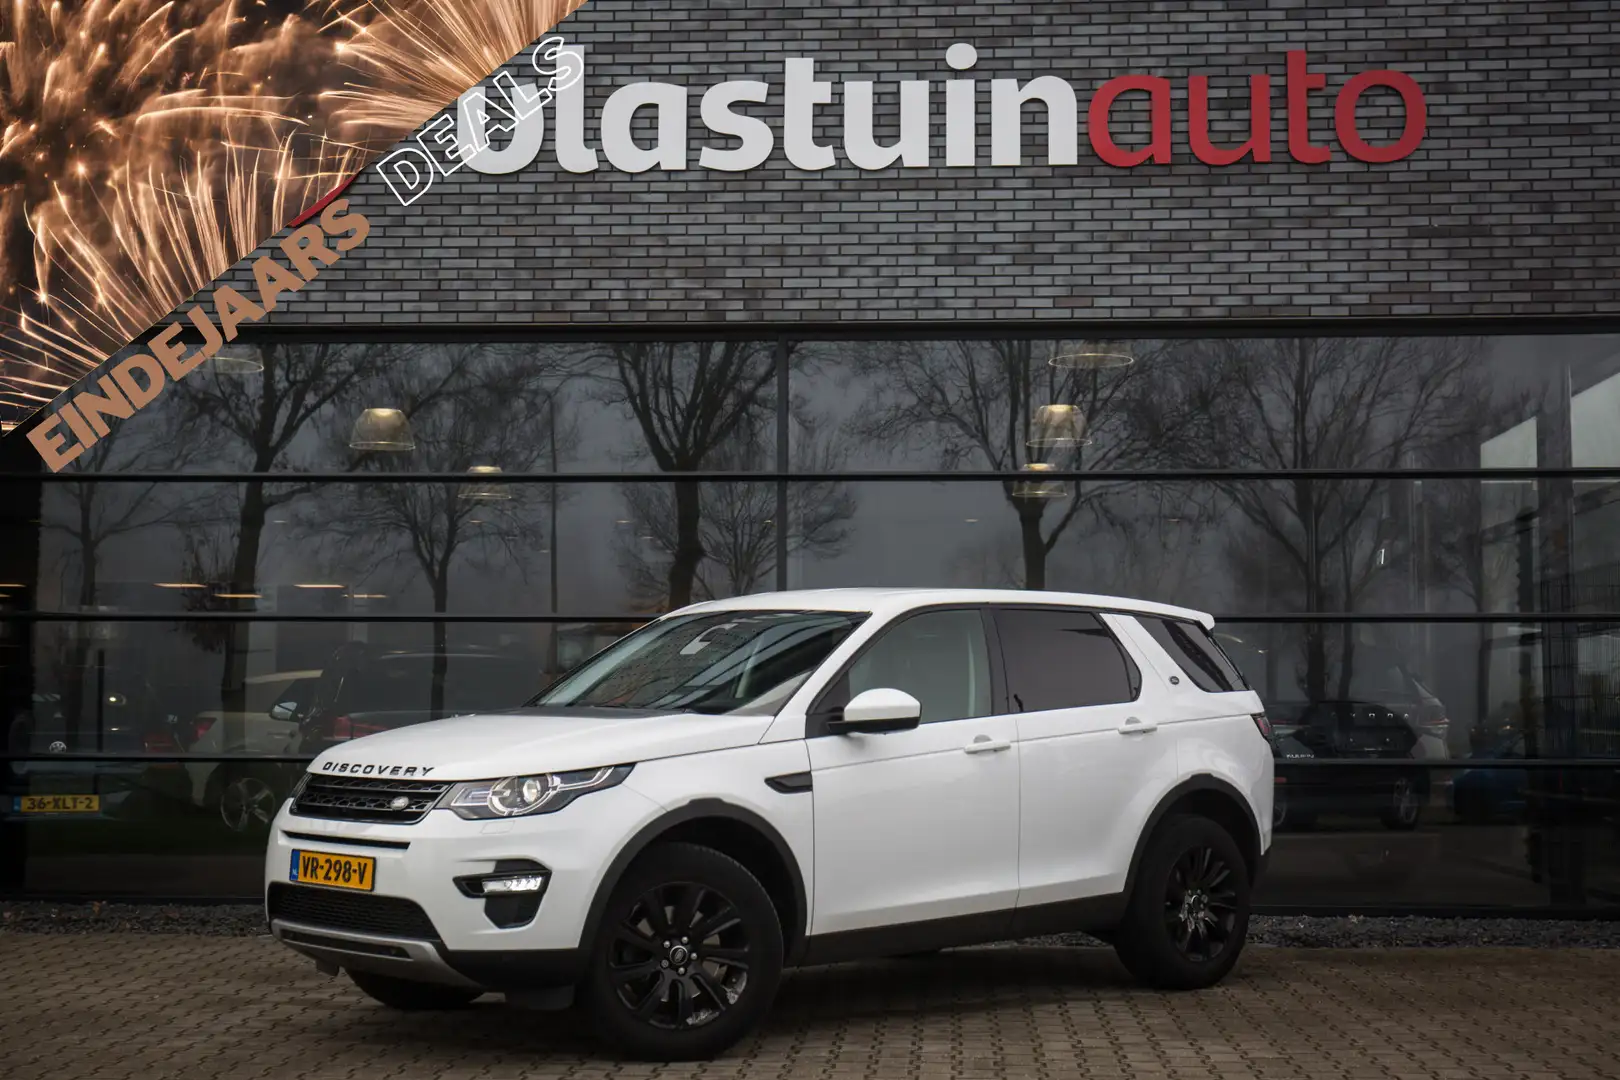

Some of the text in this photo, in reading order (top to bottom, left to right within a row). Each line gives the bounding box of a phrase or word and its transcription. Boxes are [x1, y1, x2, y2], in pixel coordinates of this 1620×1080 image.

[322, 761, 435, 776] DISCOVERY
[26, 797, 94, 810] 36-XLT-2
[302, 855, 368, 885] VR-298-V
